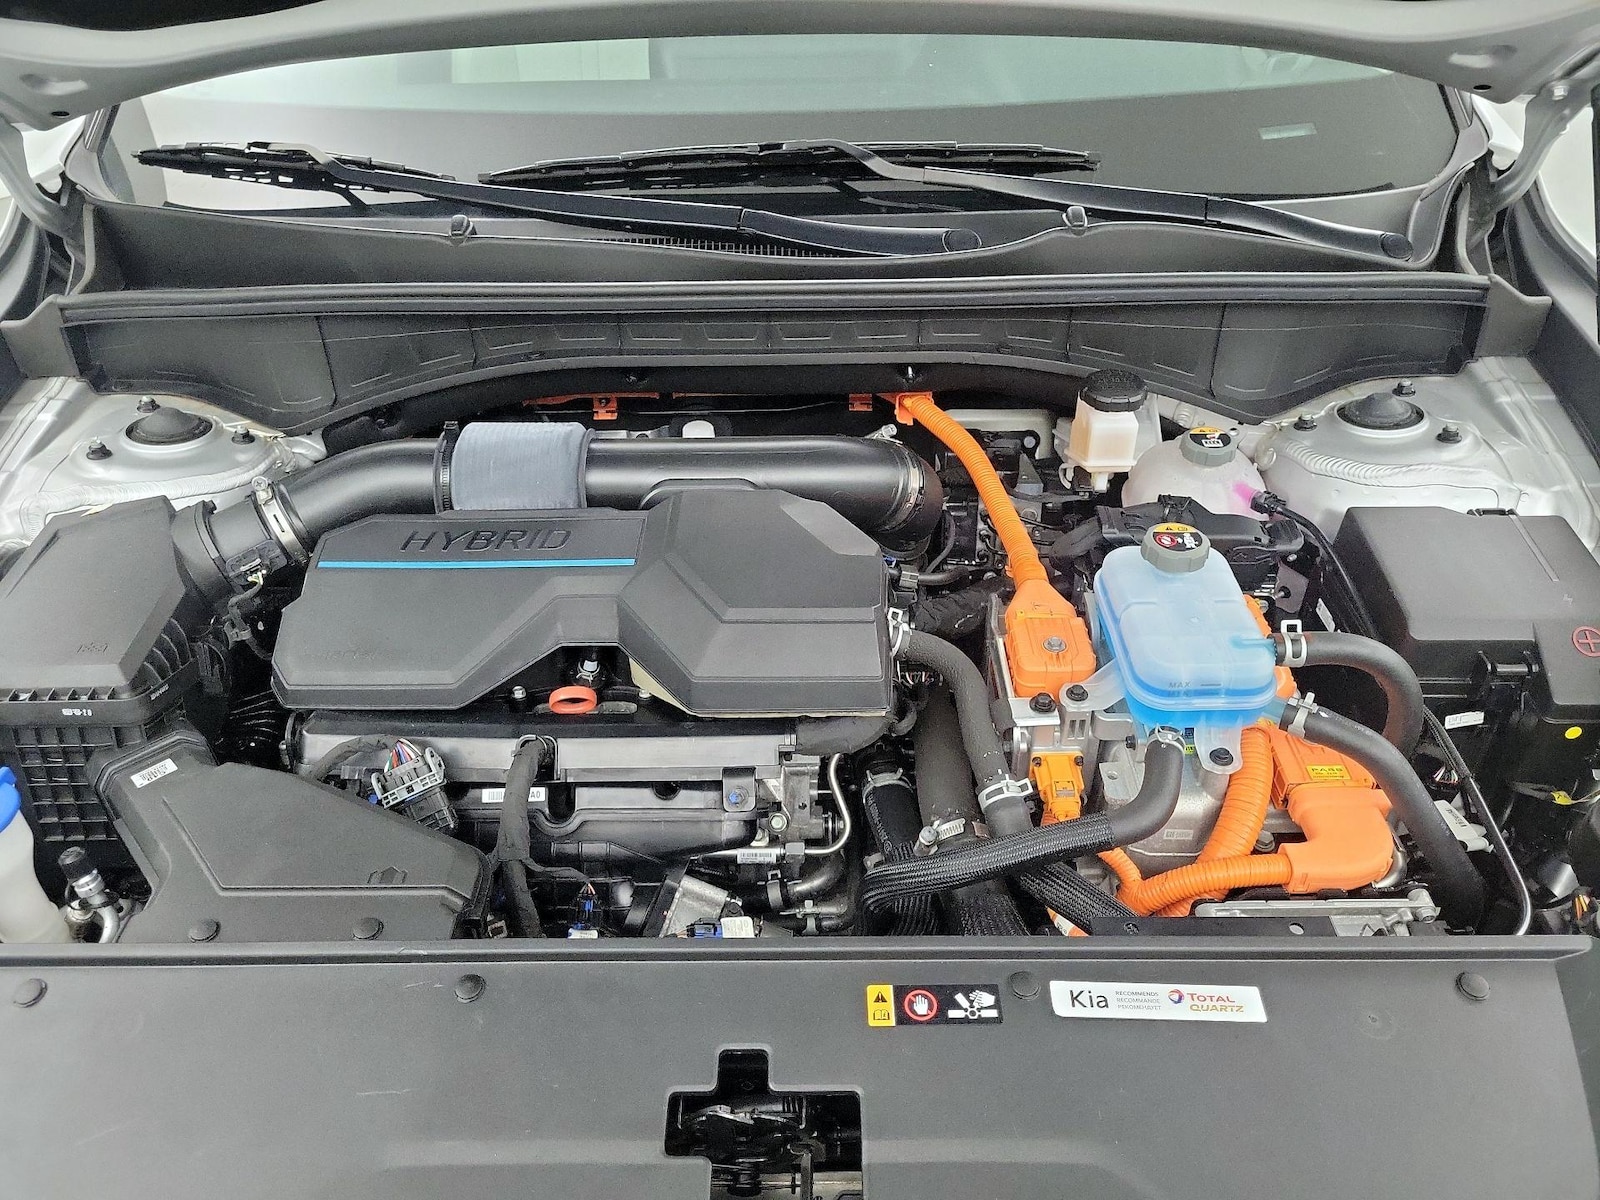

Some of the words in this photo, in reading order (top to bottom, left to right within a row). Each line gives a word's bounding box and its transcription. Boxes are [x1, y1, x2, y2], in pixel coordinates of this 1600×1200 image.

[400, 530, 572, 552] HYBRID
[1168, 681, 1191, 689] MAX
[1069, 990, 1109, 1009] Kia
[1187, 992, 1235, 1003] TOTAL
[1189, 1003, 1244, 1013] QUARTZ
